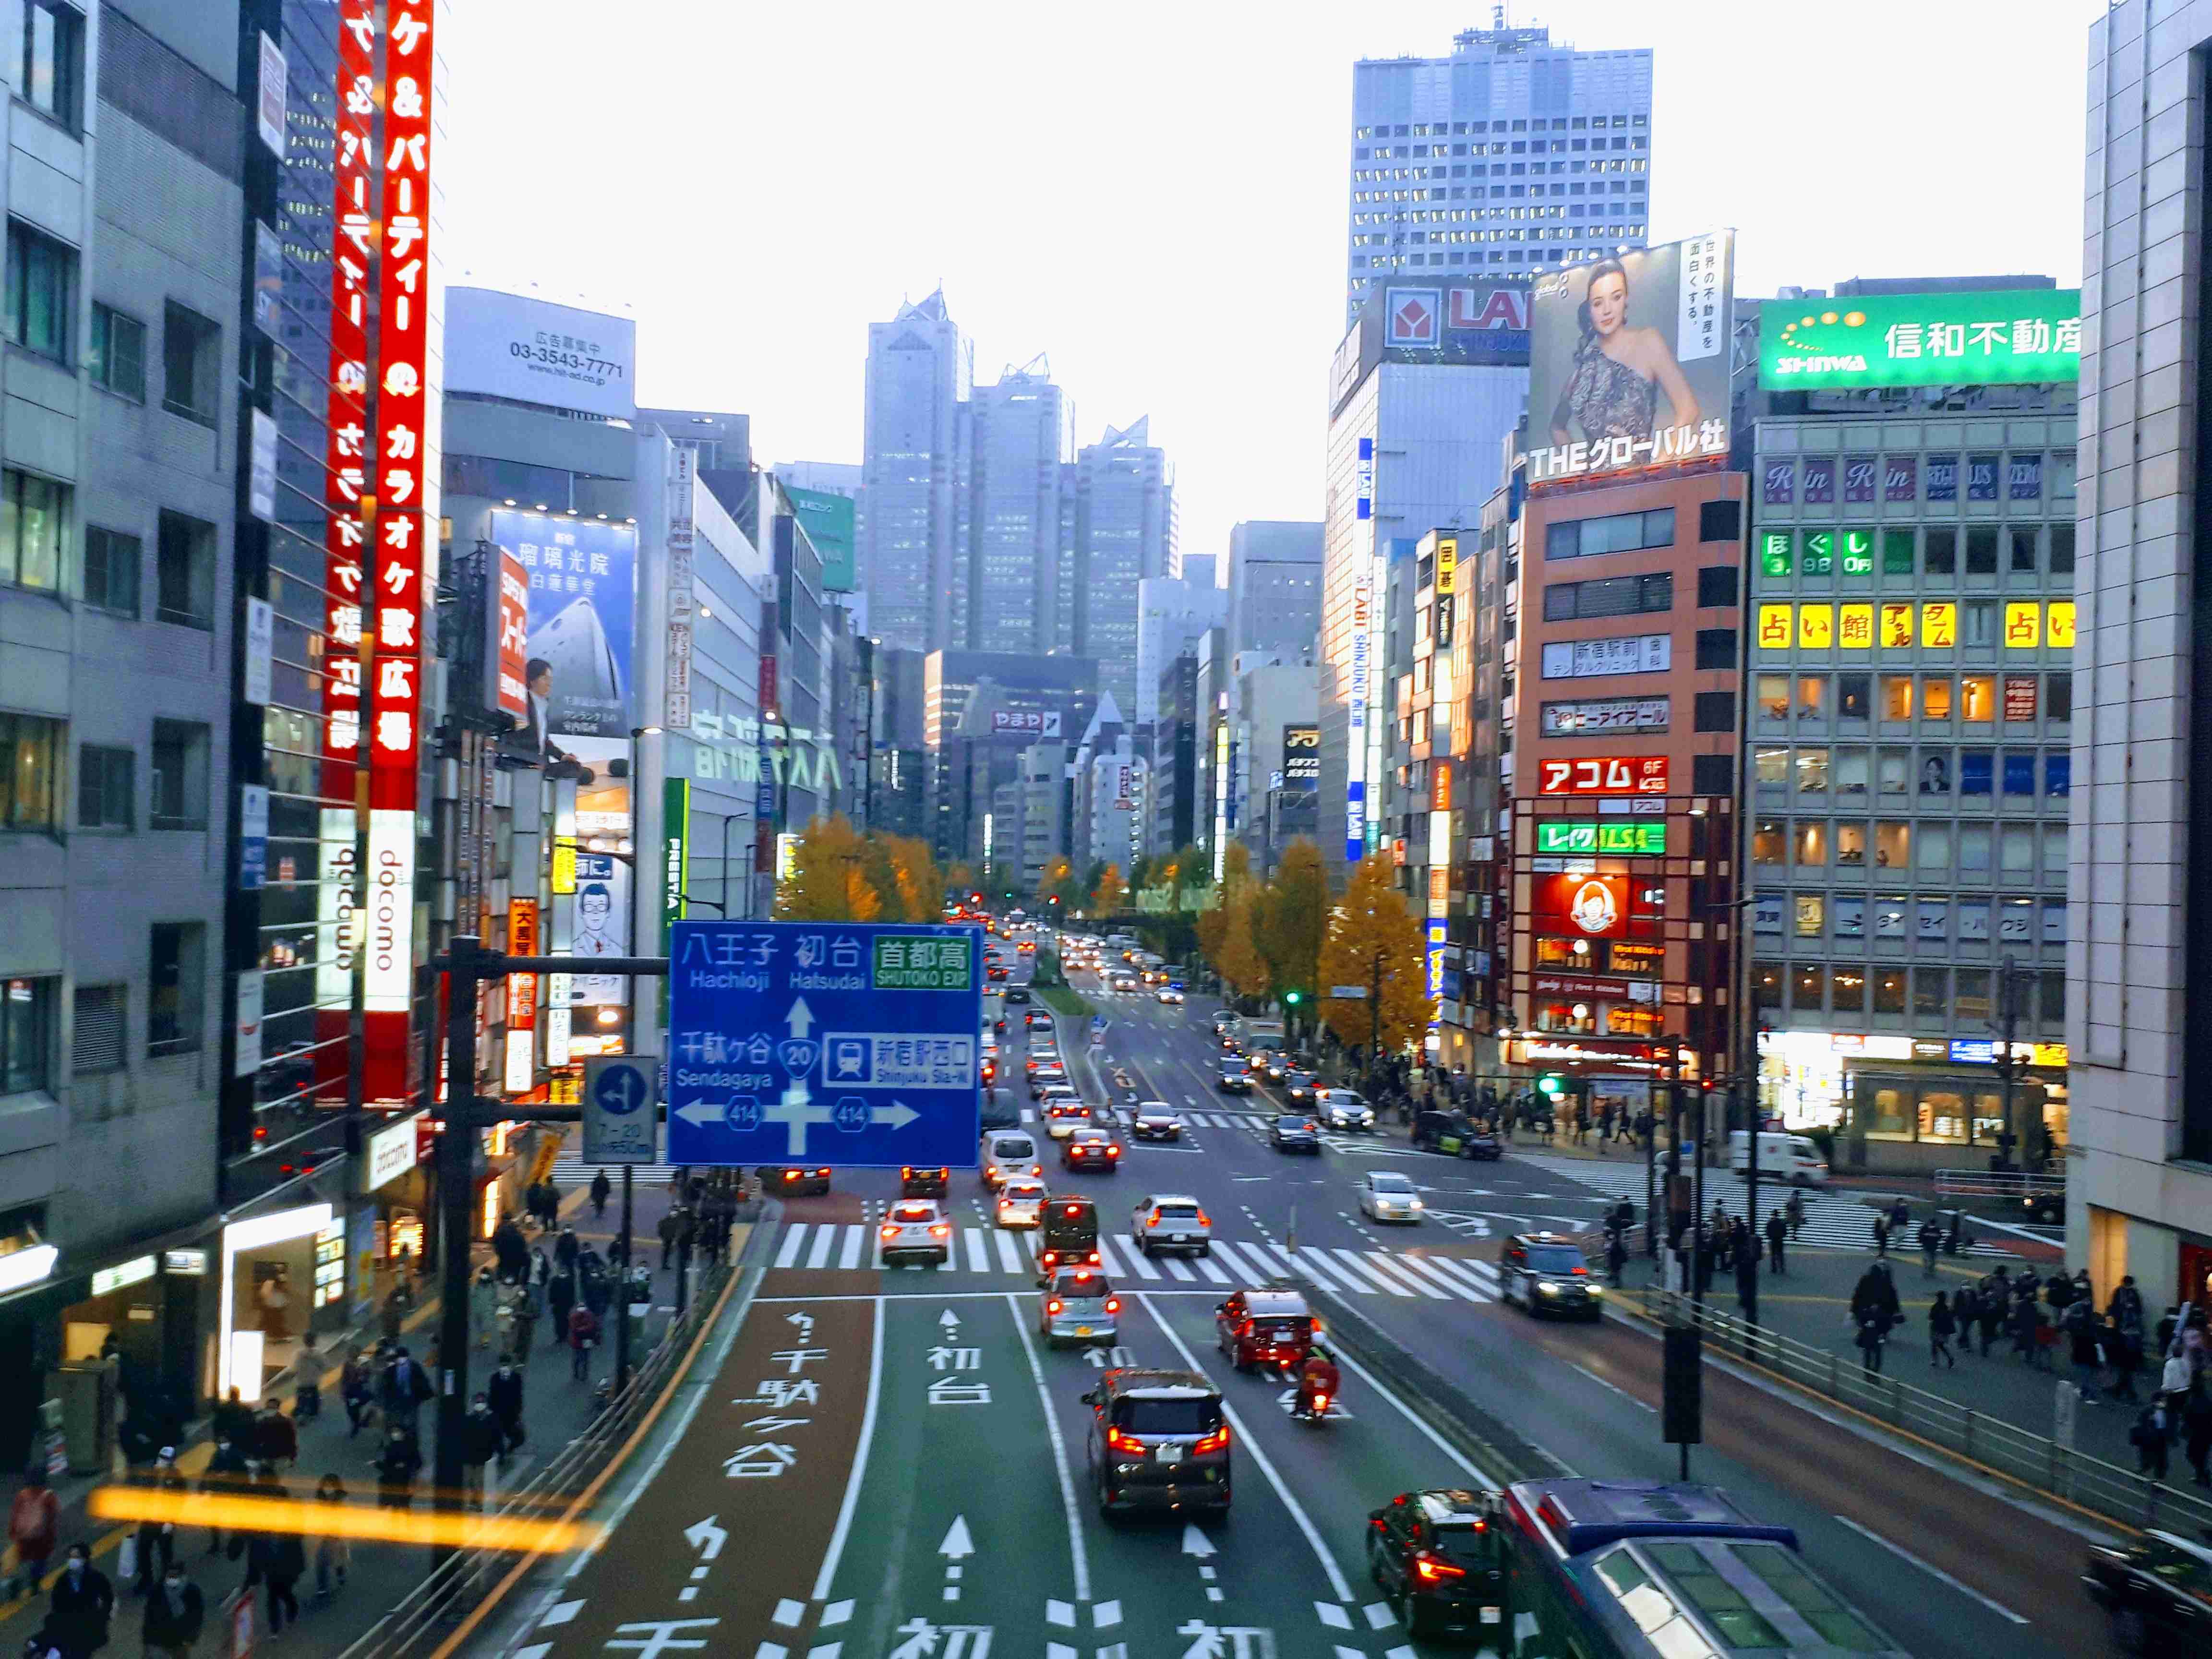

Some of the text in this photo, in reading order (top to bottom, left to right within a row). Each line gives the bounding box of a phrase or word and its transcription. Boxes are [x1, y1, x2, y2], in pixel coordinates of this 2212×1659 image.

[387, 0, 427, 330] ケ&パーティー
[1449, 289, 1536, 330] LA
[1702, 240, 1715, 349] 世界の不動産を
[534, 331, 601, 356] 広告募集中
[1885, 317, 2081, 359] 信和不動産
[510, 341, 623, 377] 03-3543-7771
[1776, 355, 1867, 374] SHINWA
[1529, 419, 1726, 477] THEグローバル社
[518, 542, 610, 576] 瑠璃光院
[1767, 531, 1868, 554] ほぐし
[378, 424, 416, 751] カラオケ歌広場
[1354, 588, 1368, 626] LABI
[1762, 613, 1871, 640] 占い館
[1352, 635, 1367, 693] SHINJUKU
[1575, 641, 1636, 660] 新宿駅前
[1546, 760, 1632, 790] アコム
[1644, 760, 1663, 774] 6F
[377, 850, 403, 972] docomo
[682, 933, 967, 970] 八王子 初台 首都高
[690, 970, 865, 992] Hachioji Hatsudai
[876, 969, 967, 987] SHUTOKO EXP
[680, 1031, 772, 1065] 千駄ヶ谷
[787, 1047, 812, 1065] 20
[876, 1039, 968, 1067] 新宿駅西口
[676, 1068, 772, 1090] Sendagaya
[729, 1106, 757, 1121] 414
[837, 1106, 866, 1122] 414
[926, 1346, 993, 1405] 初台
